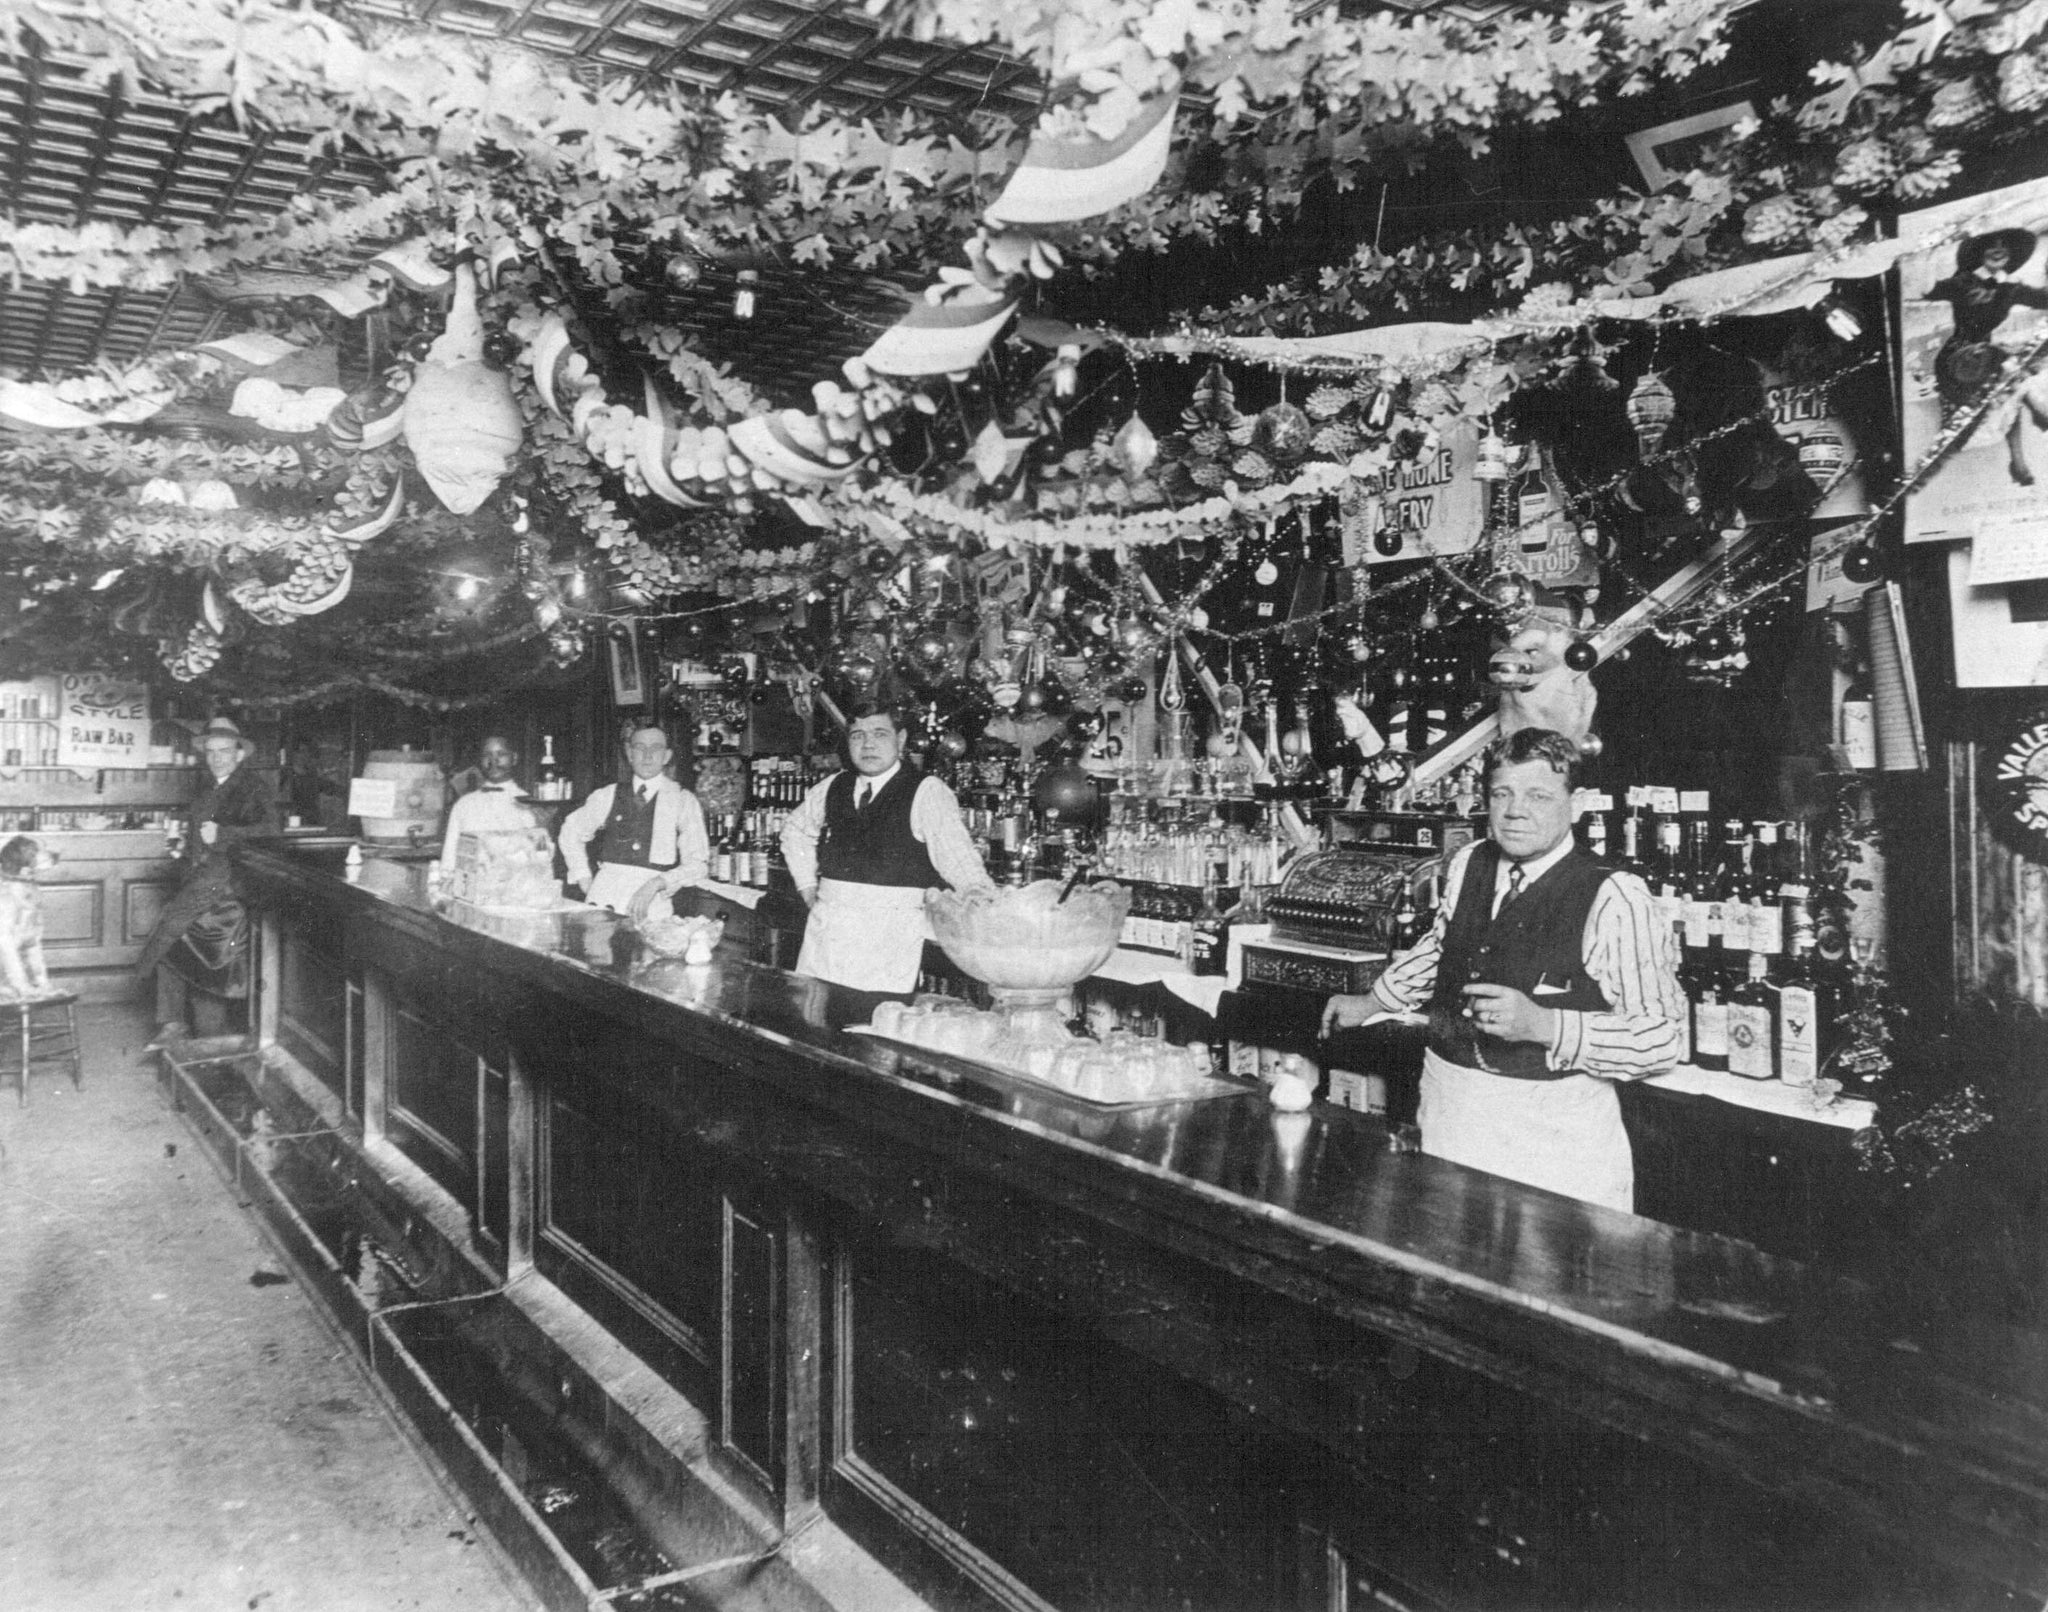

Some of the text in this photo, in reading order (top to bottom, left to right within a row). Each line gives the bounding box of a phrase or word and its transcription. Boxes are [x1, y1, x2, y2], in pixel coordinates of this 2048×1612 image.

[1399, 497, 1433, 531] FRY
[70, 703, 144, 719] STYLE
[72, 726, 134, 747] RAW BAR
[2013, 802, 2048, 838] SP
[1420, 830, 1431, 844] 25
